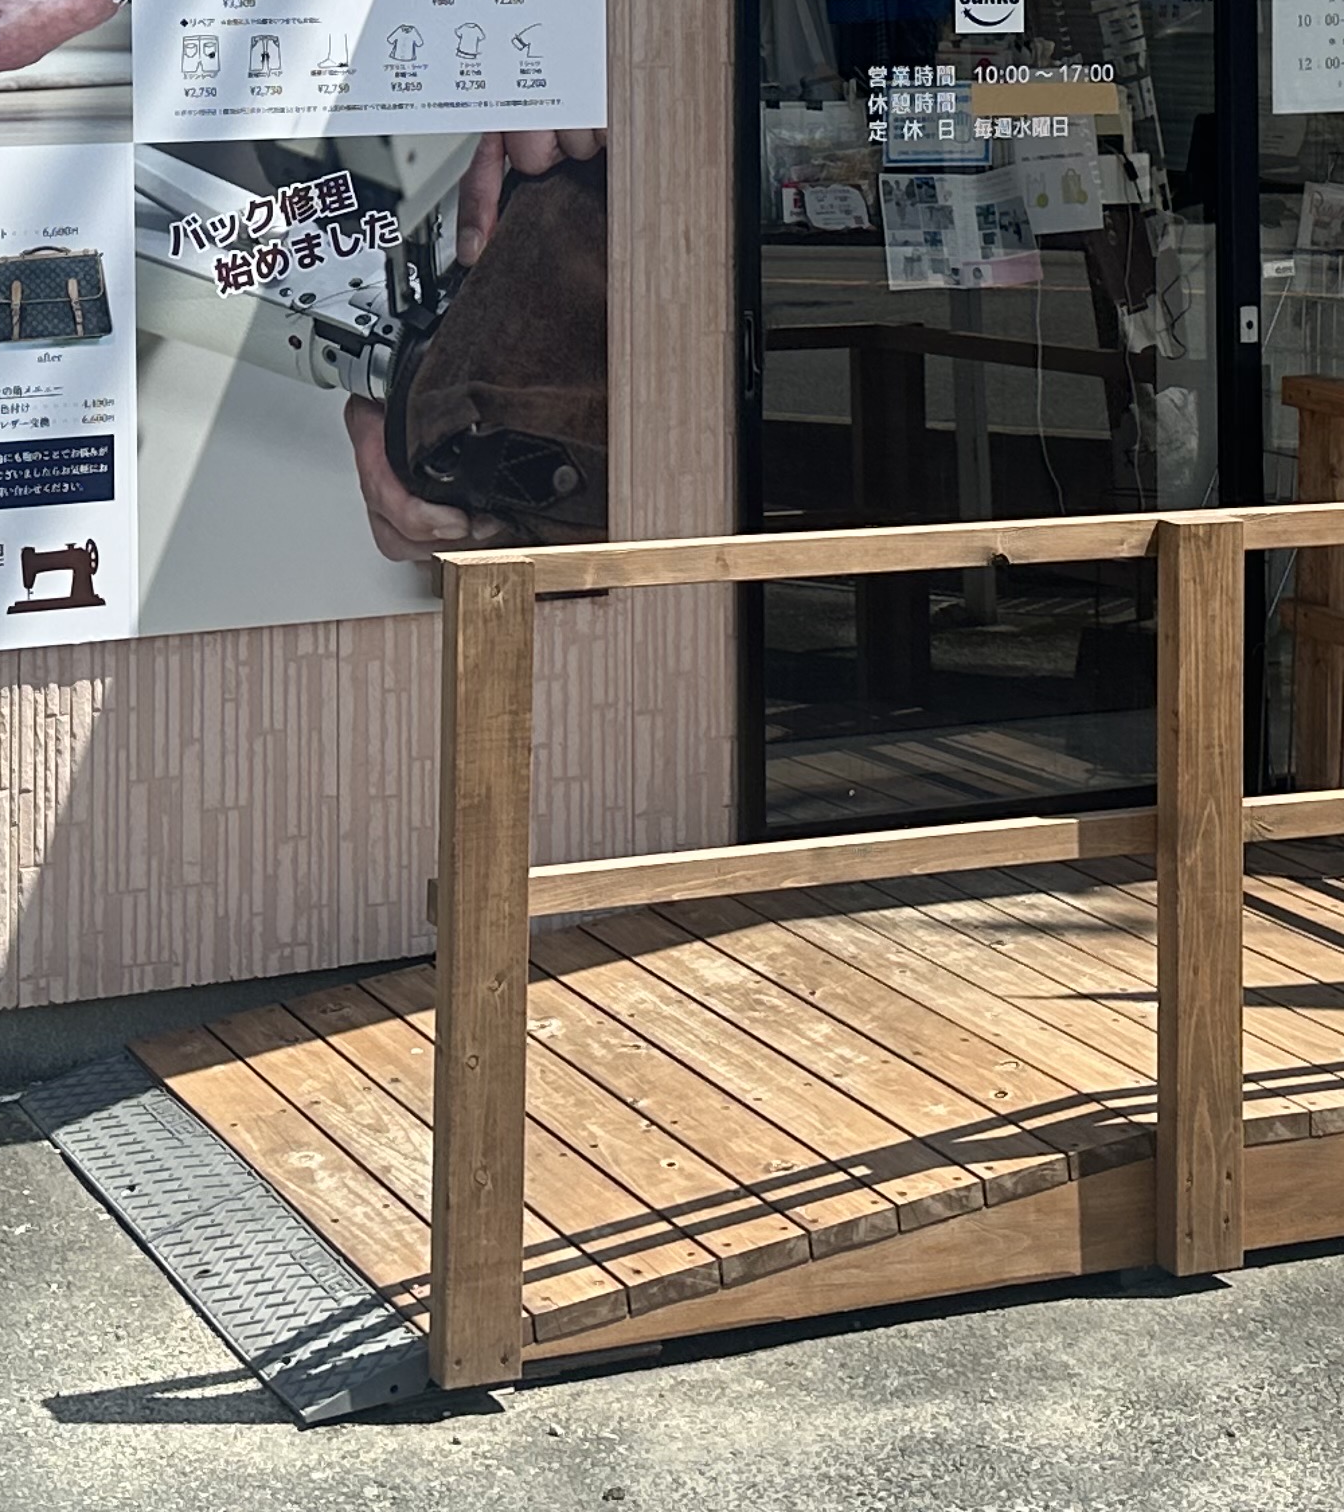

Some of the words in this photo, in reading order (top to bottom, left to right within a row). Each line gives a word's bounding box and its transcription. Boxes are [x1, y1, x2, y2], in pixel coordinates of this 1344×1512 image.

[868, 65, 956, 88] 営業時間
[868, 92, 957, 115] 休憩時間
[973, 116, 1069, 139] 毎週水曜日
[215, 212, 401, 293] 始めました
[37, 352, 63, 363] after
